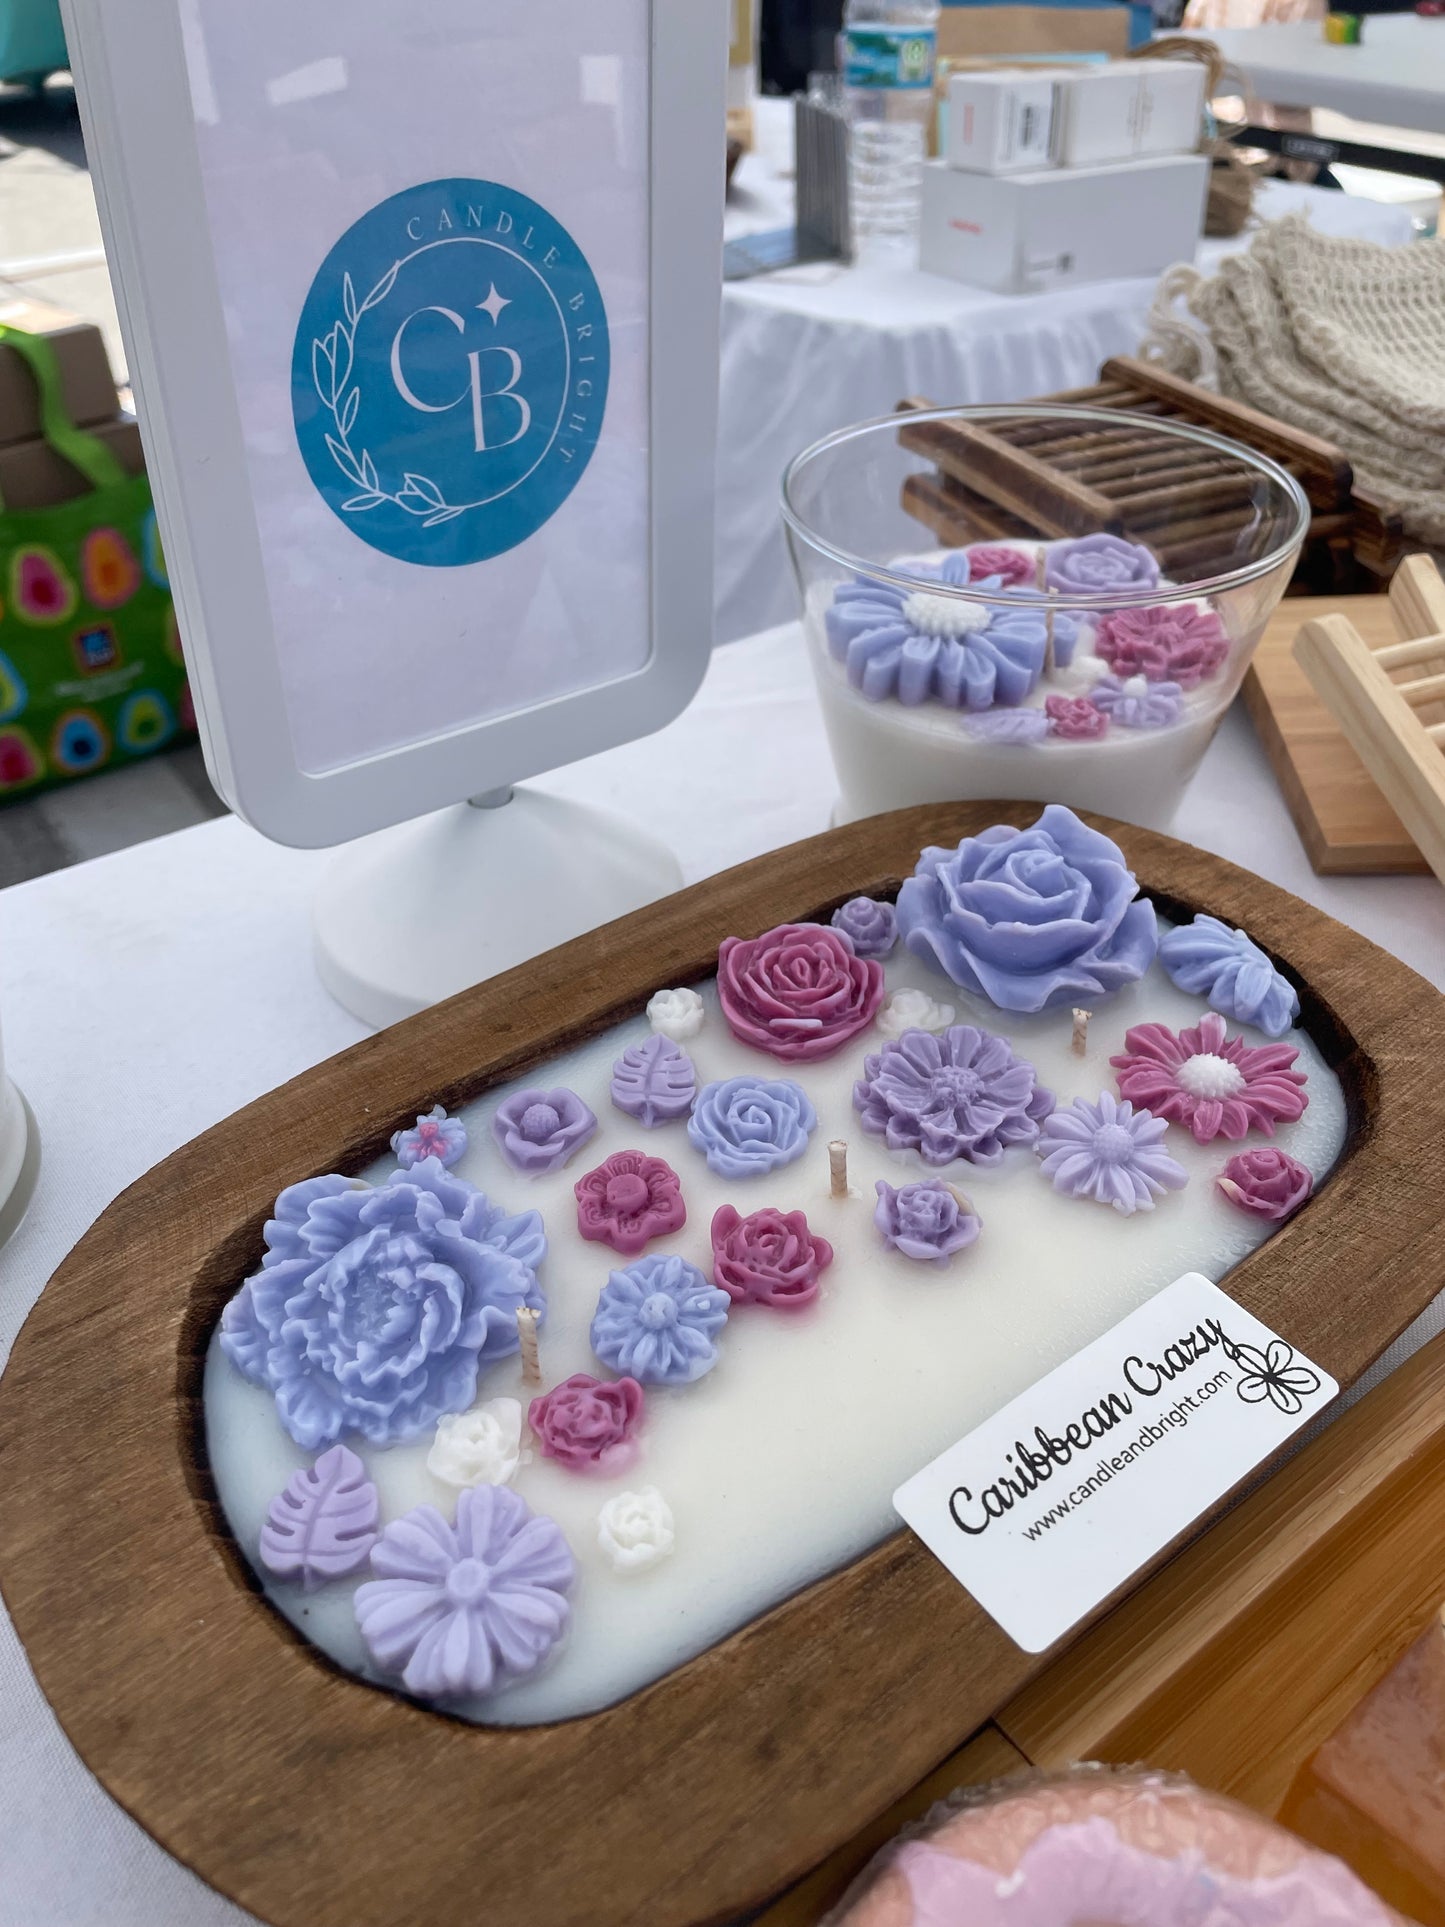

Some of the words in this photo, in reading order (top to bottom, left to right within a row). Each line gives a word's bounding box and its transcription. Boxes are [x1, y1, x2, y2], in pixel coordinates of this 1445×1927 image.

[390, 306, 532, 453] CB
[406, 205, 562, 270] CANDLE
[560, 291, 596, 465] BRIGHT
[948, 1391, 1133, 1535] Caribbean
[1123, 1318, 1241, 1397] Crazy
[1022, 1368, 1233, 1542] www.candleandbright.com
